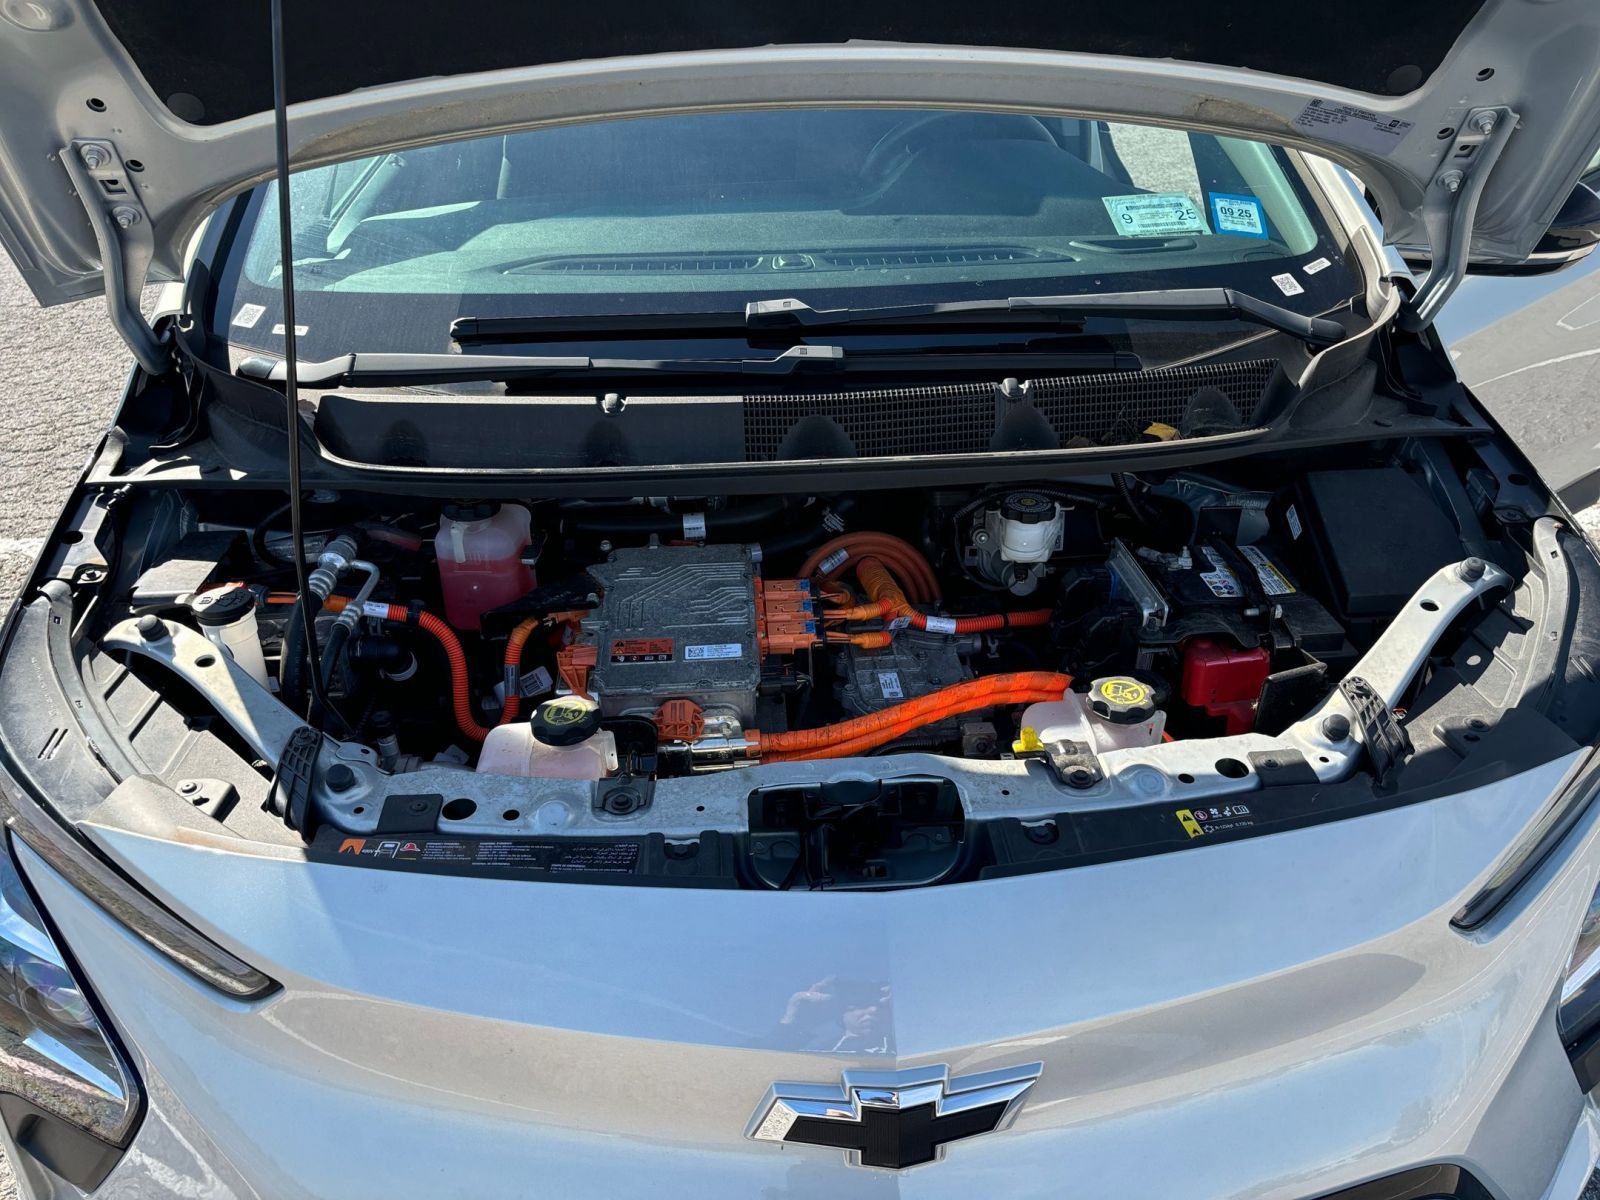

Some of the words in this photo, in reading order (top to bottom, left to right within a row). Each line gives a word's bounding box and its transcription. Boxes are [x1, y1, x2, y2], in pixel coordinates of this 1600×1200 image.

[1175, 208, 1197, 221] 25
[1220, 206, 1234, 216] 09
[1237, 208, 1252, 218] 25
[1121, 213, 1133, 224] 9
